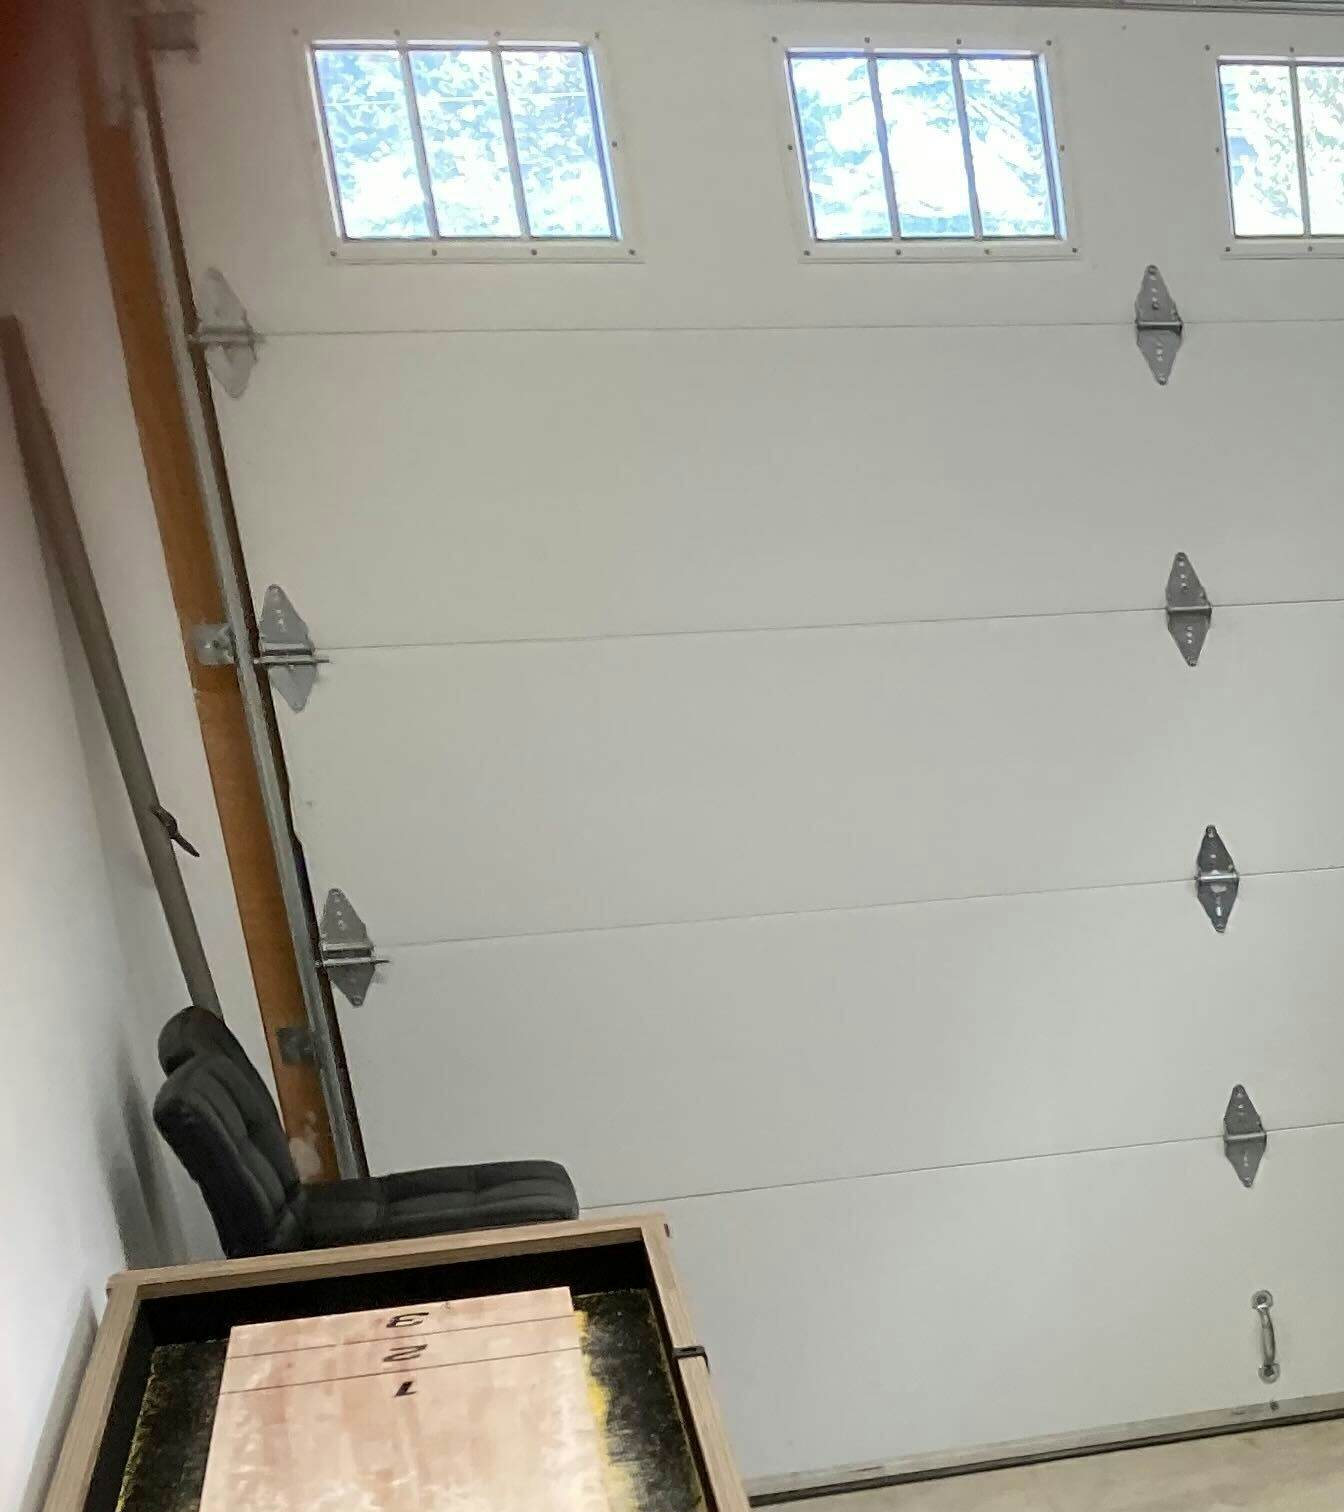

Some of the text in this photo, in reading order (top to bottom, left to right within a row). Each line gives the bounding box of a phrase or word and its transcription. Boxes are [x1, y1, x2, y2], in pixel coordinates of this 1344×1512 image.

[386, 1312, 429, 1328] 3
[383, 1344, 428, 1362] 2
[394, 1381, 417, 1397] 1
